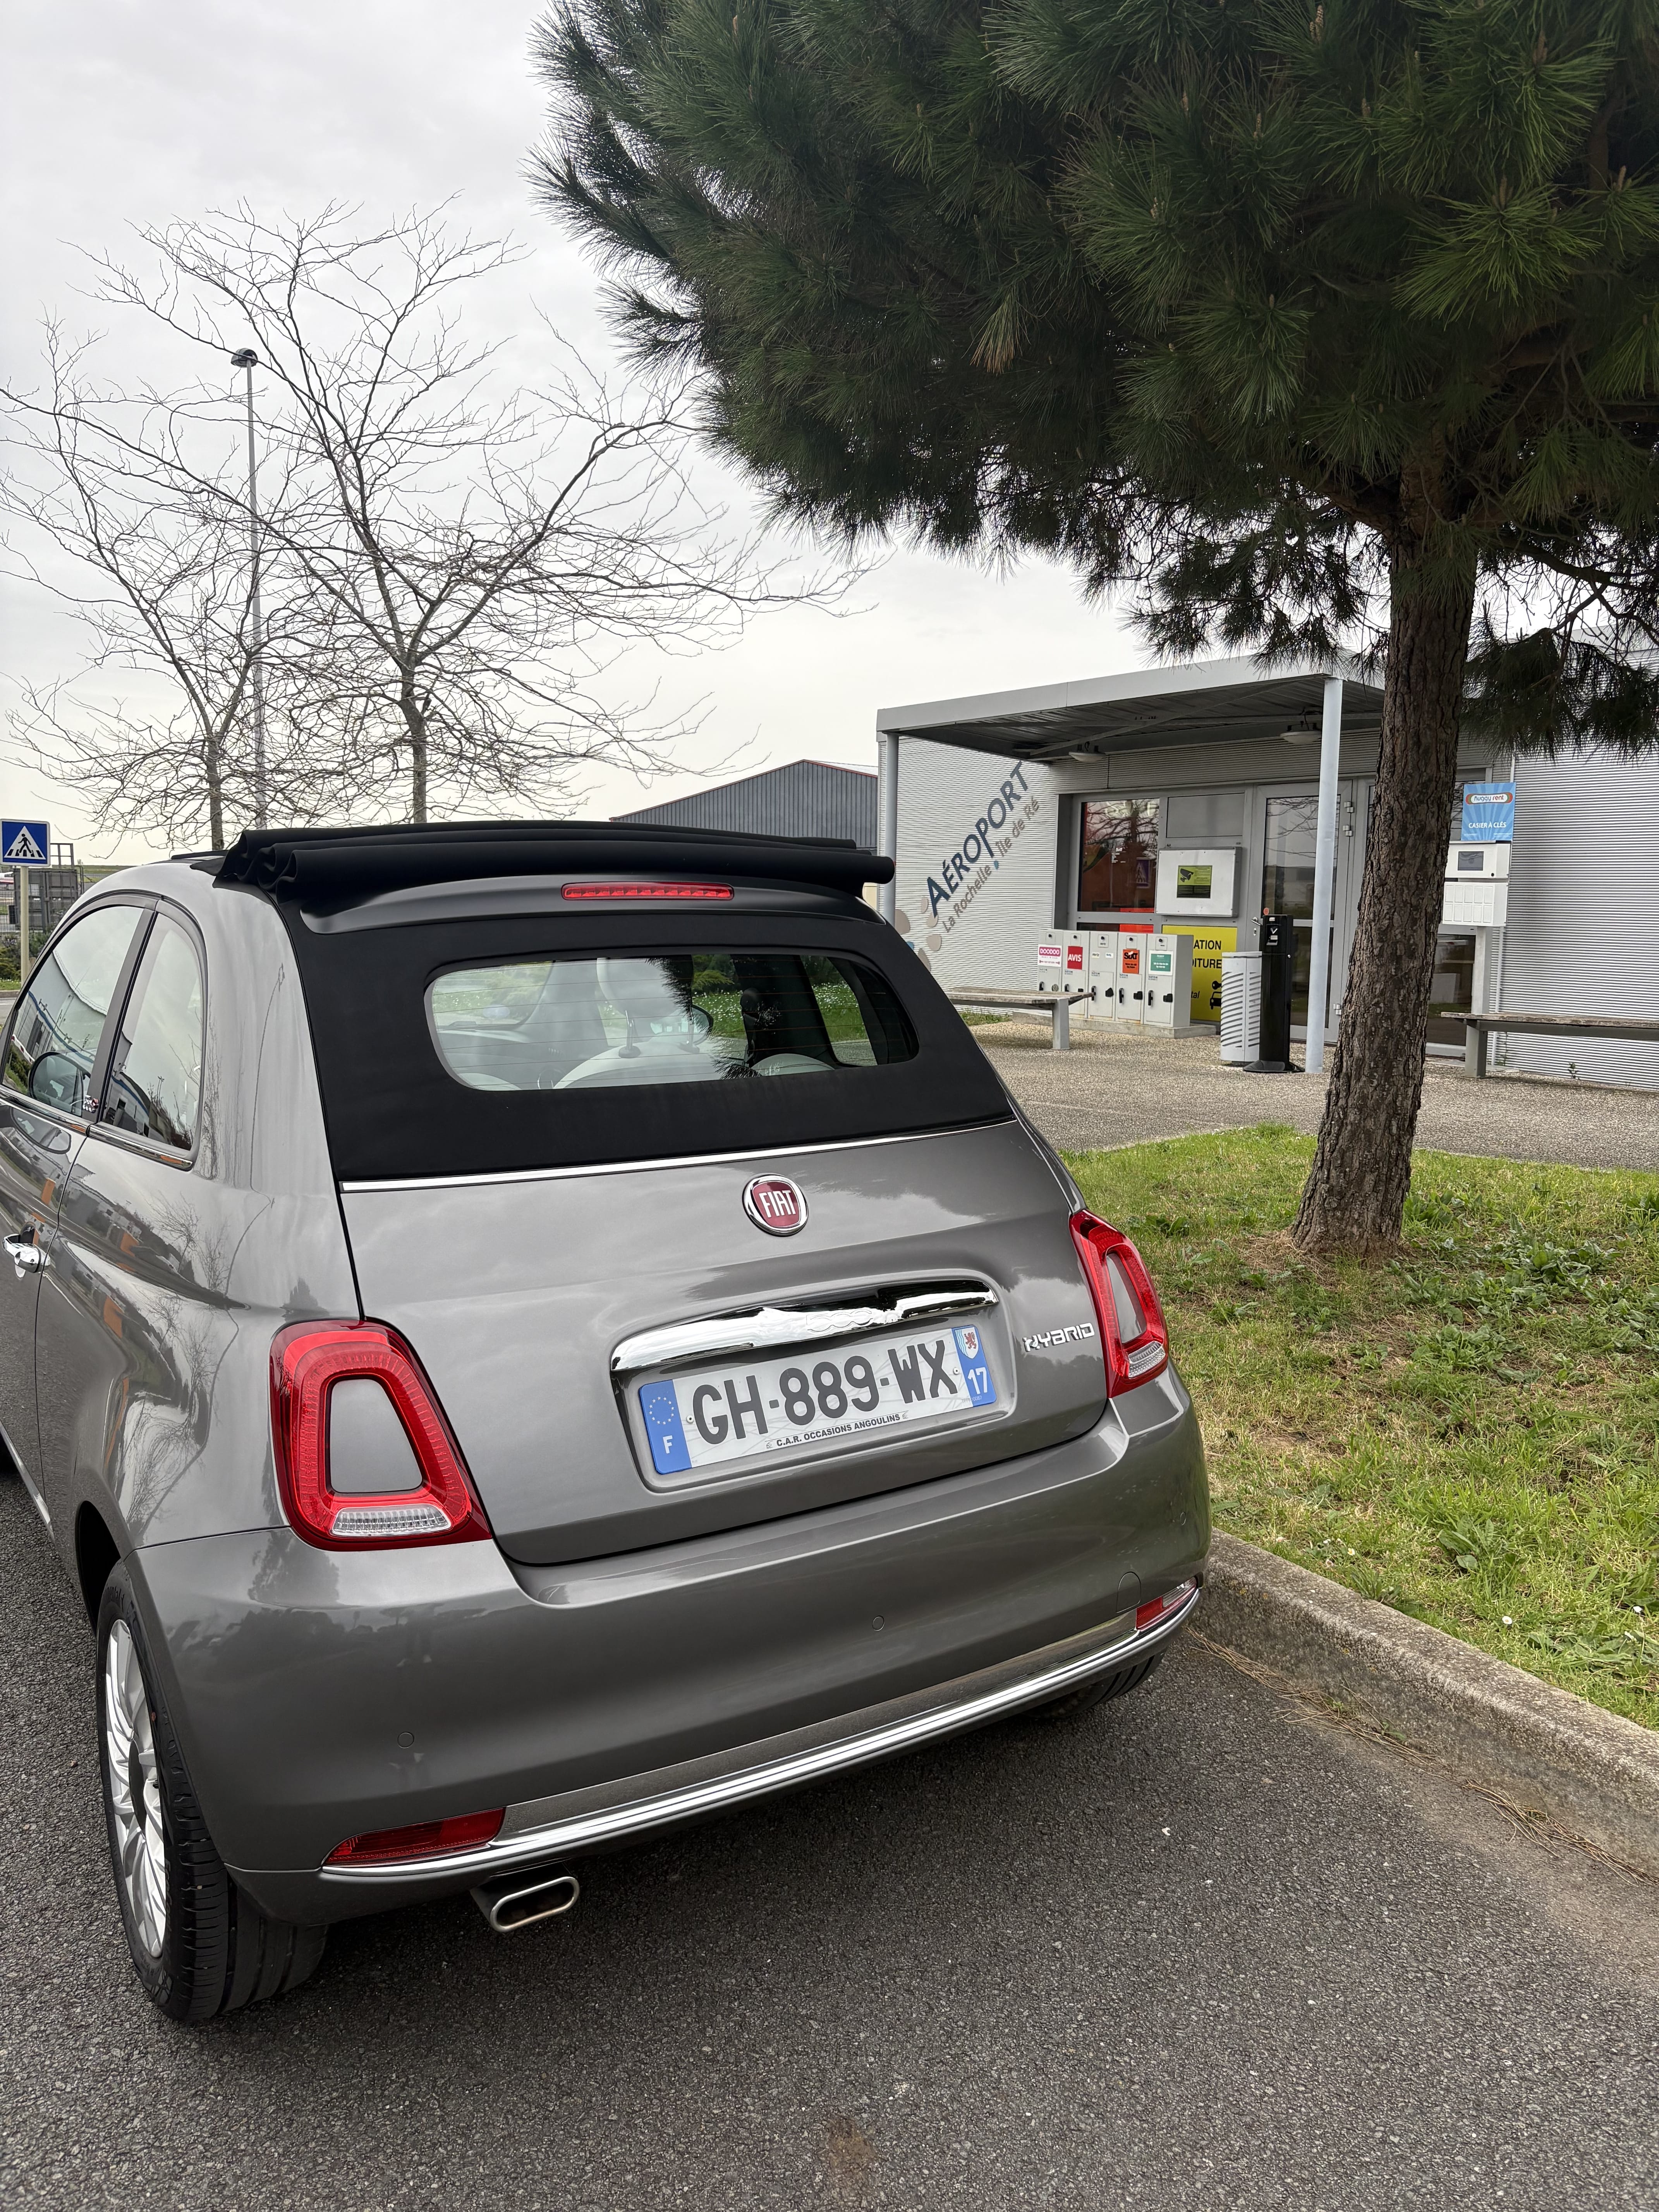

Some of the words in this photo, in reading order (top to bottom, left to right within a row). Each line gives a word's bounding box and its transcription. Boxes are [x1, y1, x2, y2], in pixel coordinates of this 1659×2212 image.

[927, 761, 1028, 918] AÉROPORT
[942, 915, 955, 933] La
[953, 864, 992, 919] Rochelle
[1012, 819, 1025, 838] de
[1024, 796, 1040, 821] Ré
[1068, 954, 1082, 962] AVIS
[1194, 939, 1221, 950] ATION
[759, 1190, 796, 1218] FIAT
[1023, 1322, 1095, 1352] HYBRID
[693, 1340, 958, 1444] GH-889-WX
[968, 1367, 988, 1394] 17
[663, 1435, 673, 1454] F
[777, 1436, 802, 1446] C.A.R.
[804, 1424, 852, 1441] OCCASIONS
[854, 1414, 900, 1430] ANGOULINS
